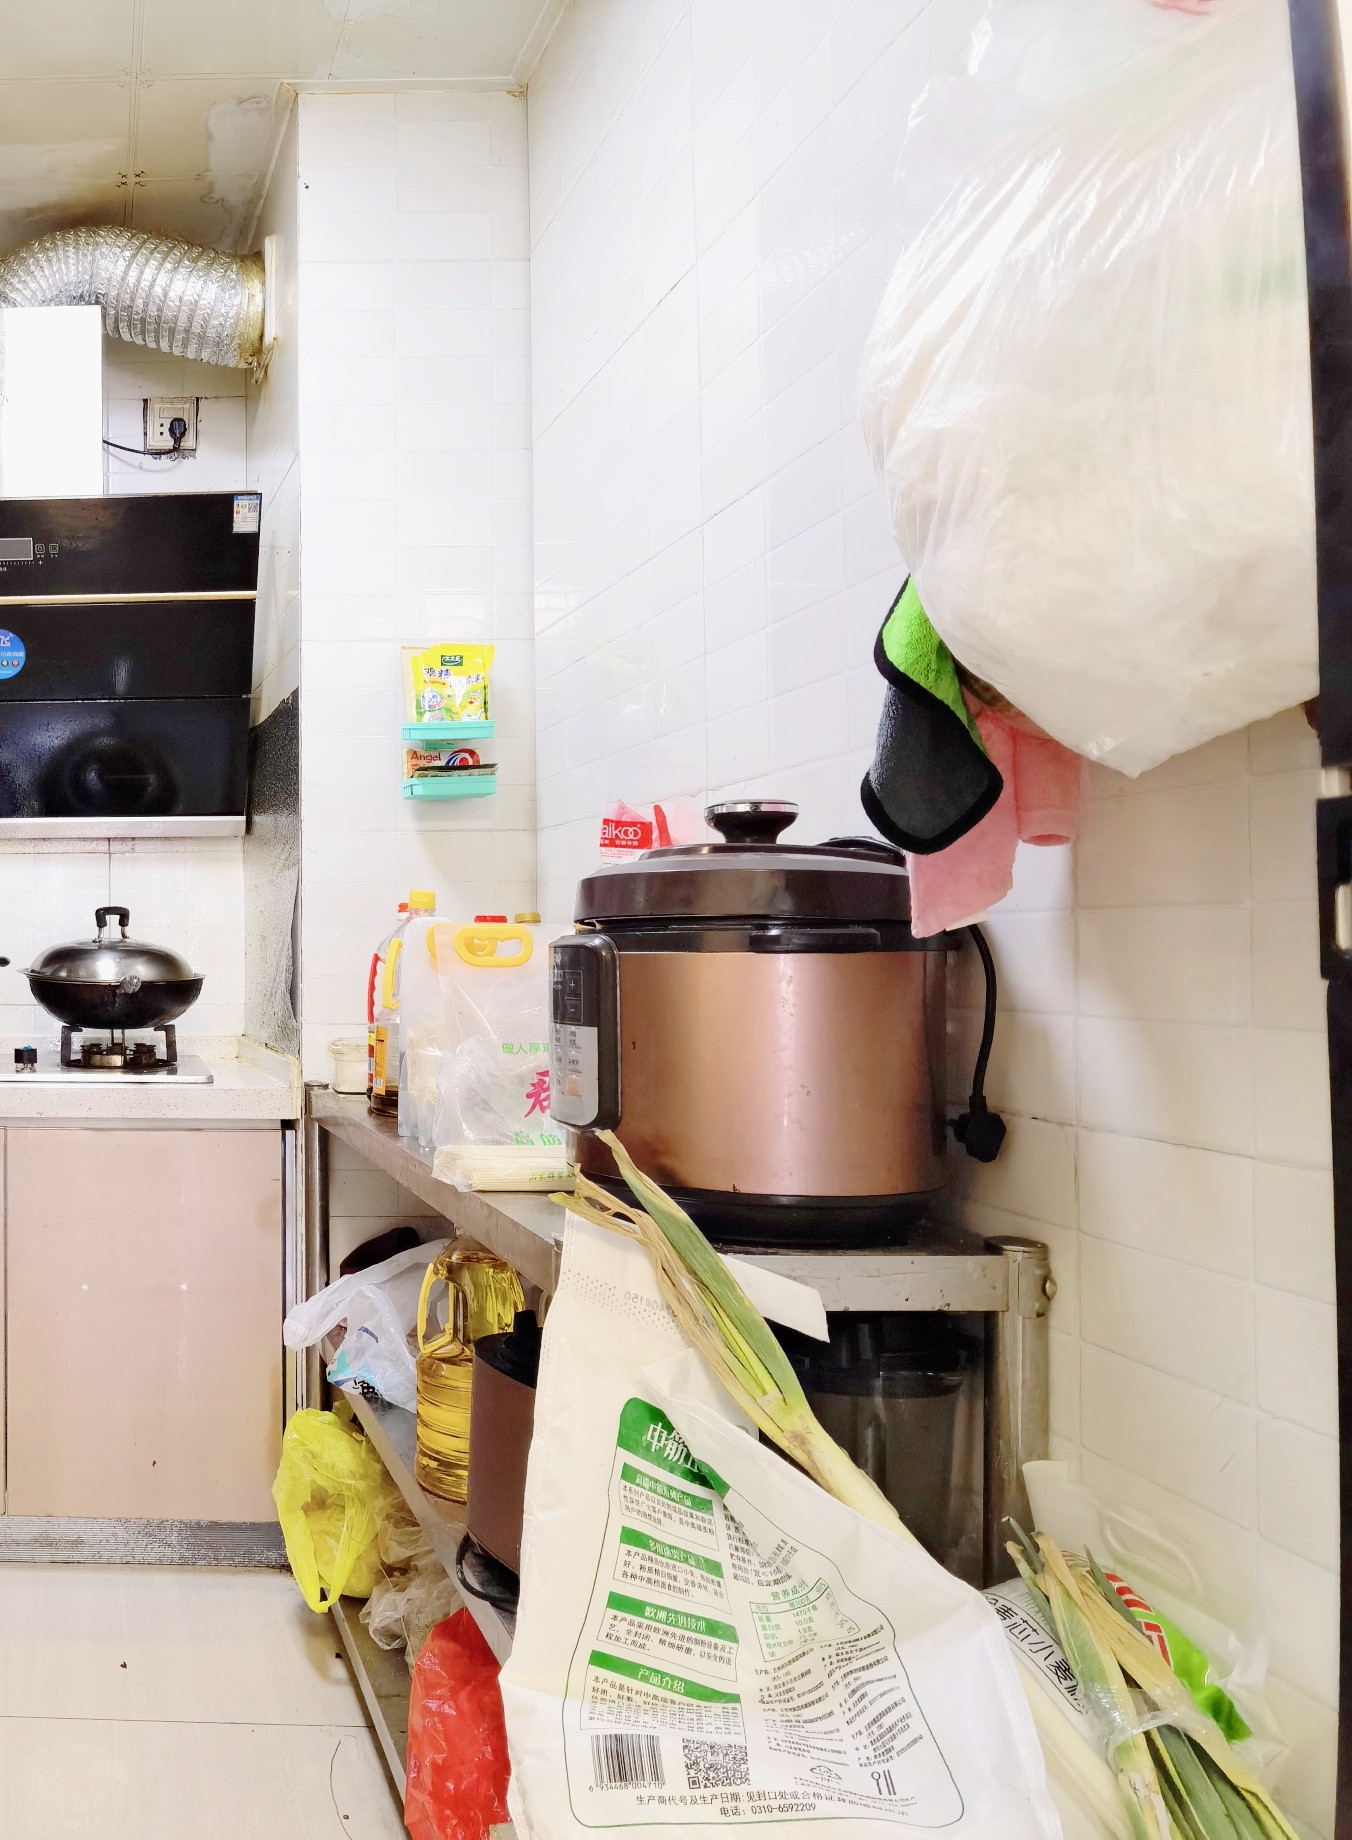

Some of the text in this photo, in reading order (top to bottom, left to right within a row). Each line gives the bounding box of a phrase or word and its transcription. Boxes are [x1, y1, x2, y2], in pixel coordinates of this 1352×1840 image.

[411, 751, 441, 763] Angel
[644, 1605, 707, 1633] 欧洲先进技术
[638, 1667, 686, 1694] 产品介绍
[599, 1781, 629, 1791] 934468
